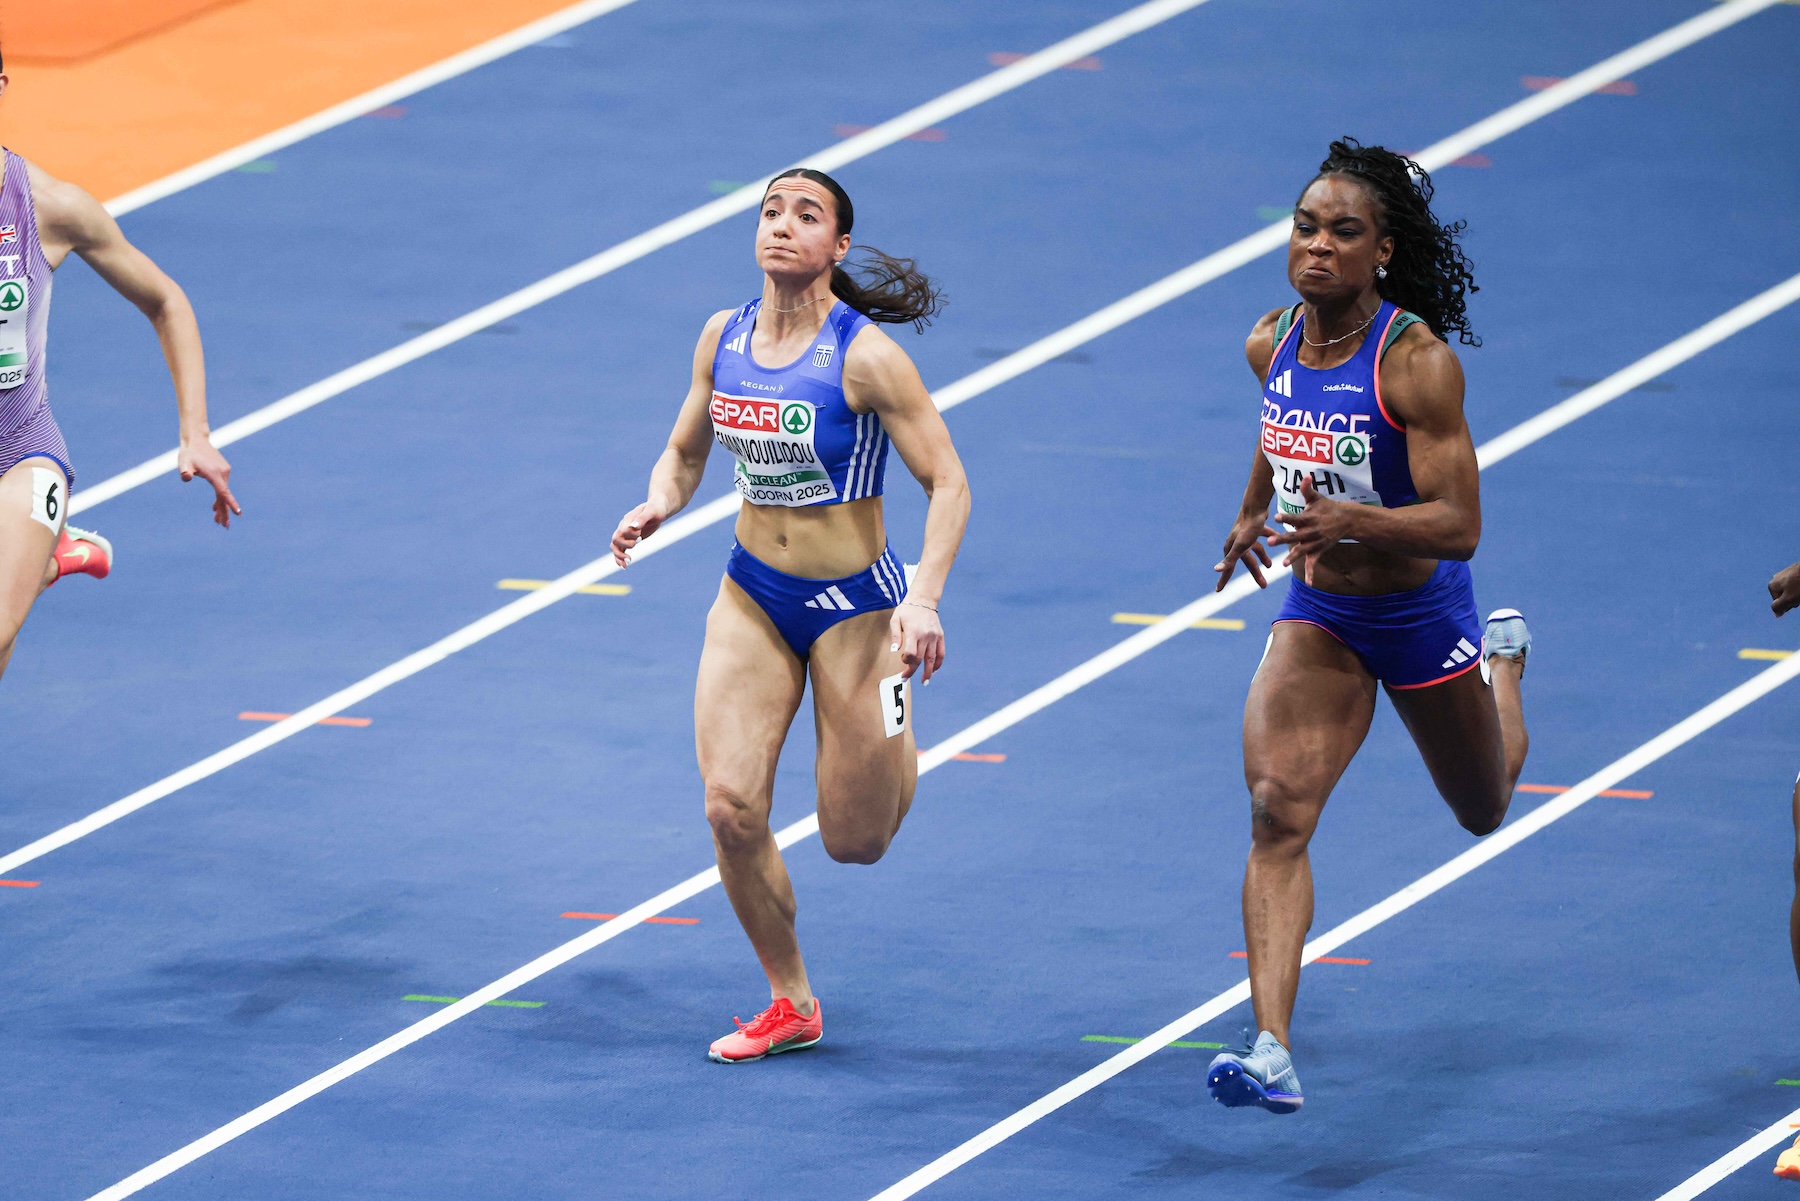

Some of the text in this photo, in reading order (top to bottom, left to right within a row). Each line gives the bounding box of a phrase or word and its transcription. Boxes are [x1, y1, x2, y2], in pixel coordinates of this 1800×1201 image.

[740, 380, 777, 392] AEGEAN
[711, 399, 778, 428] SPAR
[1264, 427, 1332, 460] SPAR
[796, 483, 830, 501] 2025
[1279, 465, 1346, 495] ZAHI
[46, 482, 58, 521] 6
[893, 683, 905, 726] 5
